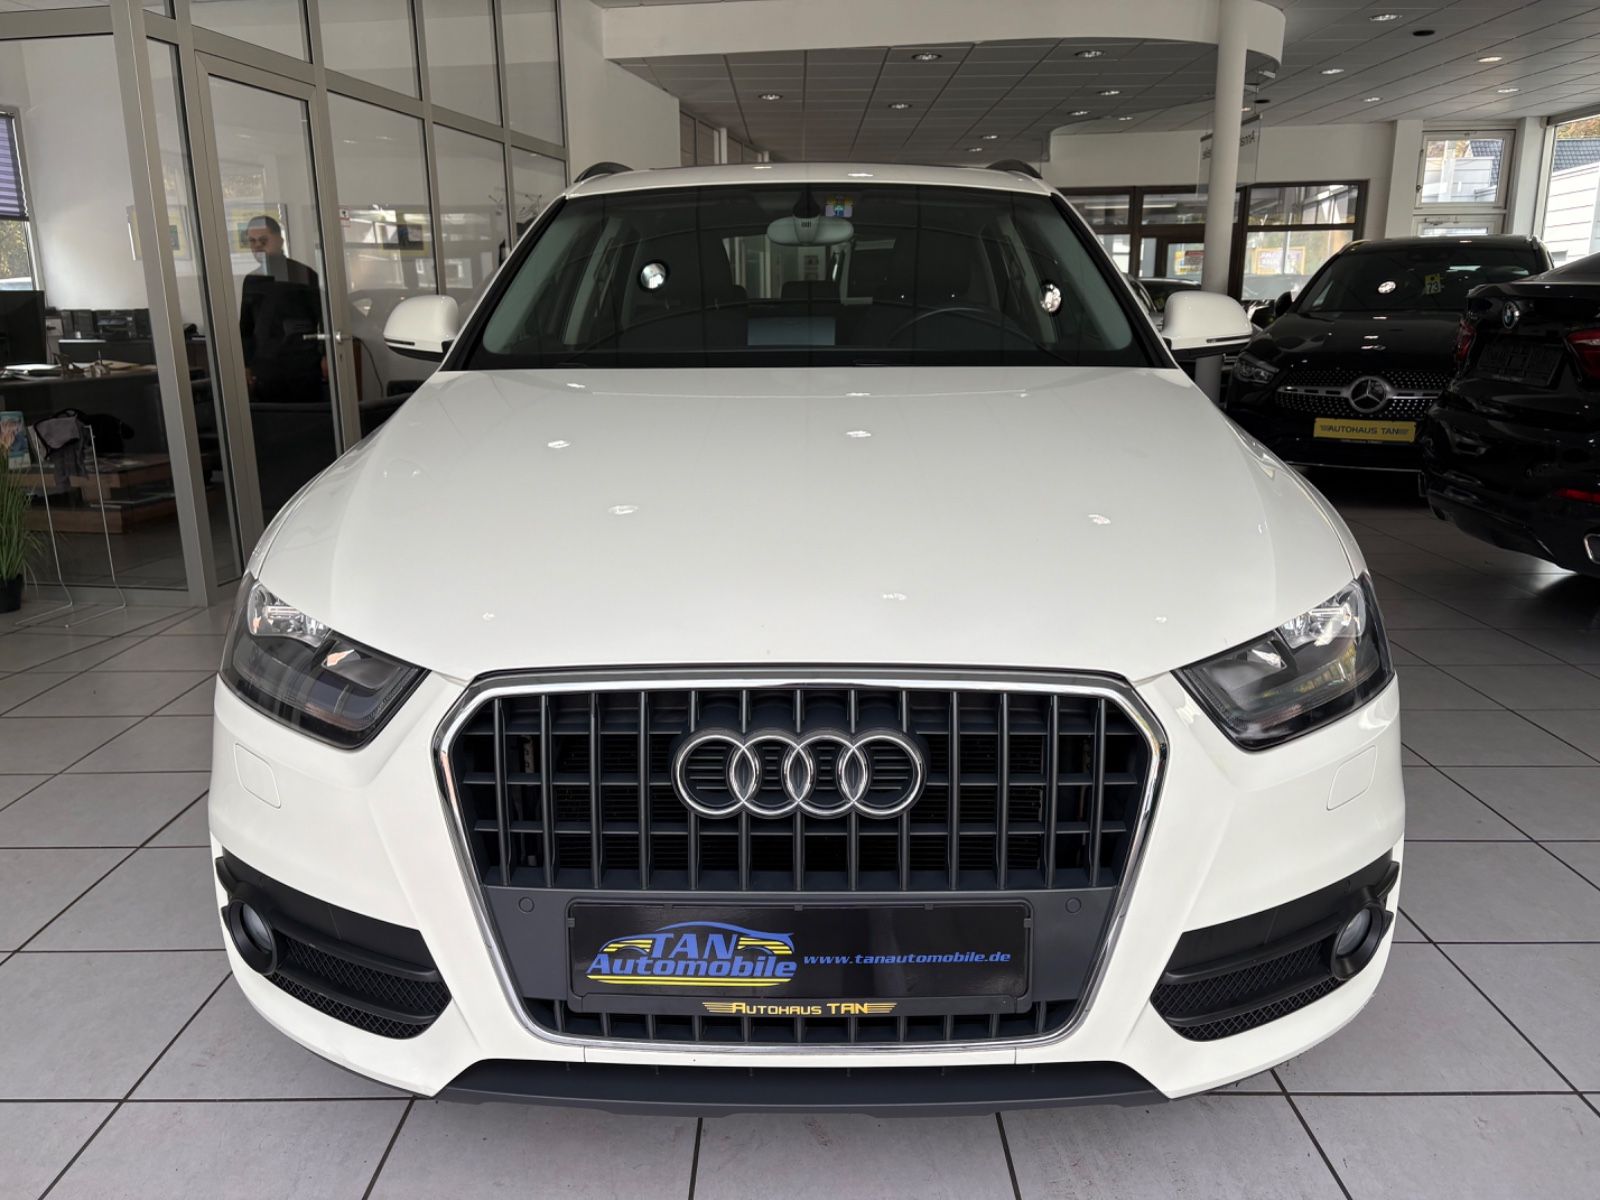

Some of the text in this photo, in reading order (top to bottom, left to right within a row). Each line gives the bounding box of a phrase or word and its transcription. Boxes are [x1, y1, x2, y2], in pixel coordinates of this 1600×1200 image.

[1327, 424, 1399, 435] AUTOHAUS TAN
[650, 933, 738, 960] TAN
[586, 953, 798, 977] Automobile
[803, 951, 1012, 965] www.tanautomobile.de
[731, 1002, 869, 1015] AUTOHAUS TAN
